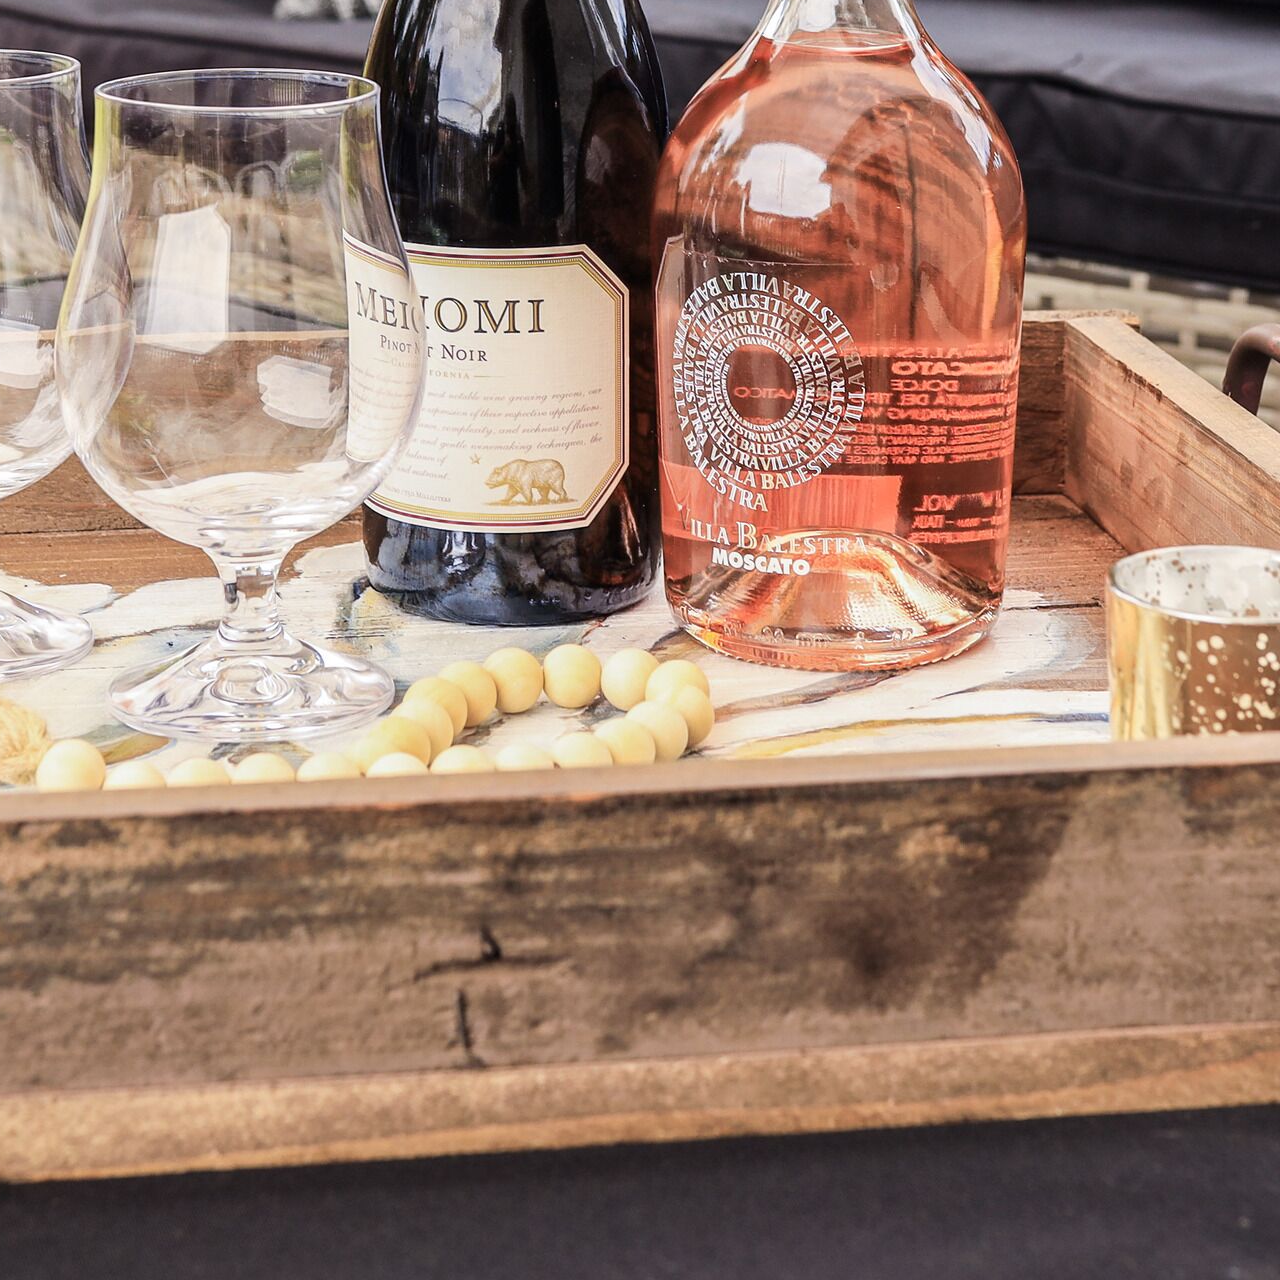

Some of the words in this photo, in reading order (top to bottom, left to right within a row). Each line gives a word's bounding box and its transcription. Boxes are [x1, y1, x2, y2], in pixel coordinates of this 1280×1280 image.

[720, 272, 784, 295] VILLA
[670, 276, 722, 360] BALESTRA
[780, 280, 862, 368] BALESTRA
[441, 344, 488, 362] NOIR
[672, 361, 690, 429] VILLA
[682, 343, 710, 446] BALESTRA
[839, 370, 865, 438] VILLA
[682, 431, 767, 511] BALESTRA
[705, 444, 757, 487] VILLA
[761, 429, 853, 489] BALESTRA
[712, 547, 811, 576] MOSCATO
[736, 521, 868, 555] BALESTRA
